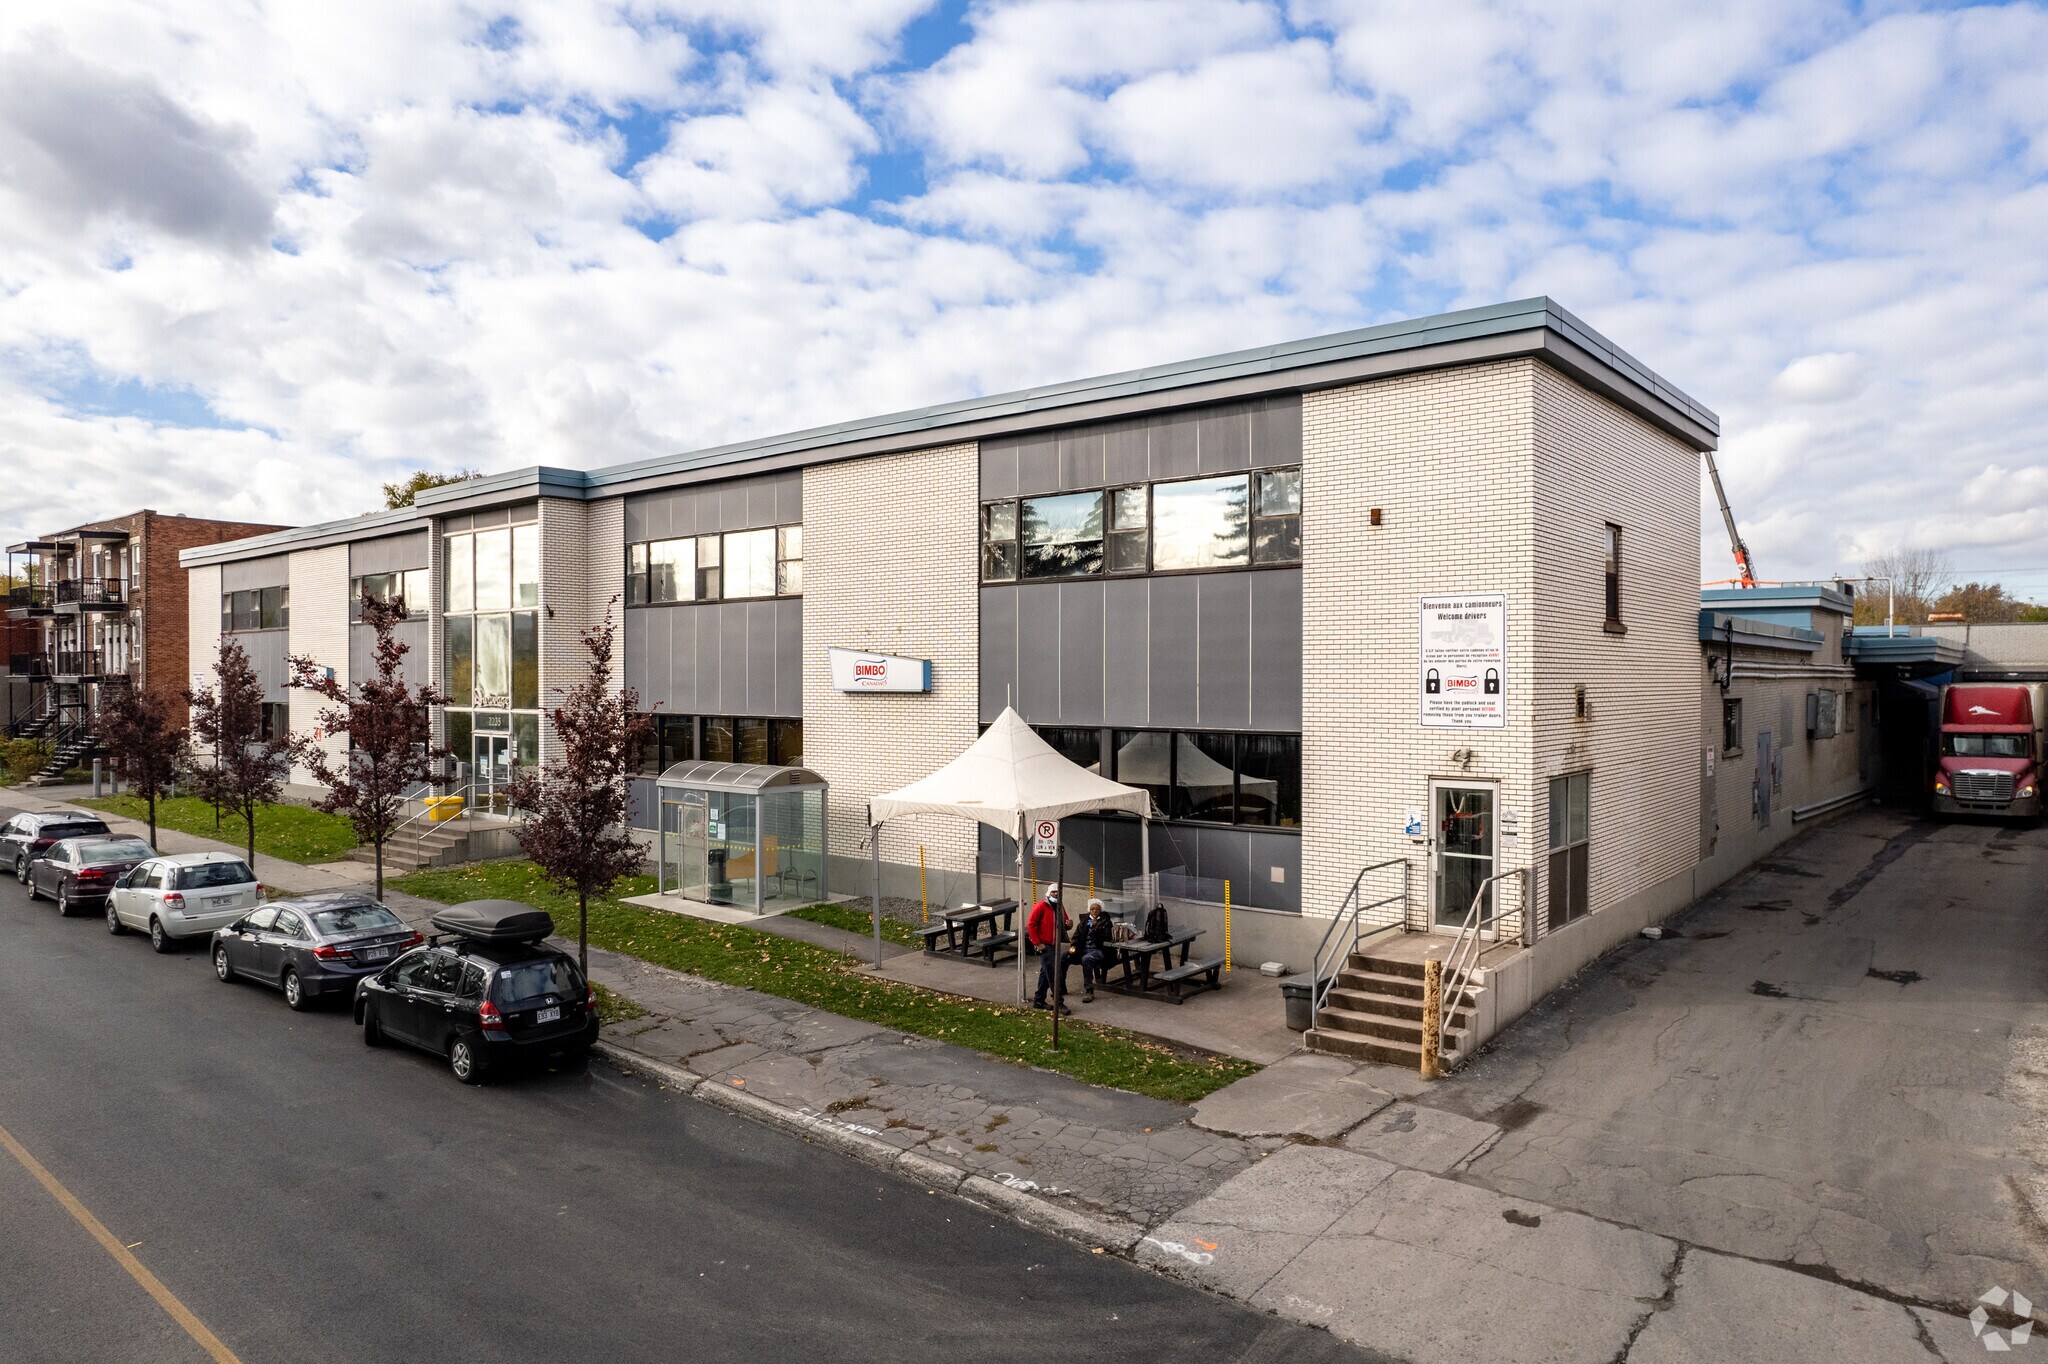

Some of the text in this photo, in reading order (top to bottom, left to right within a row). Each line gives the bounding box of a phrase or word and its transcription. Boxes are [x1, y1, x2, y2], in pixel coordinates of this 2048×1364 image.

[1464, 612, 1487, 620] drivers
[855, 665, 885, 675] BIMBO
[1447, 679, 1477, 687] BIMBO
